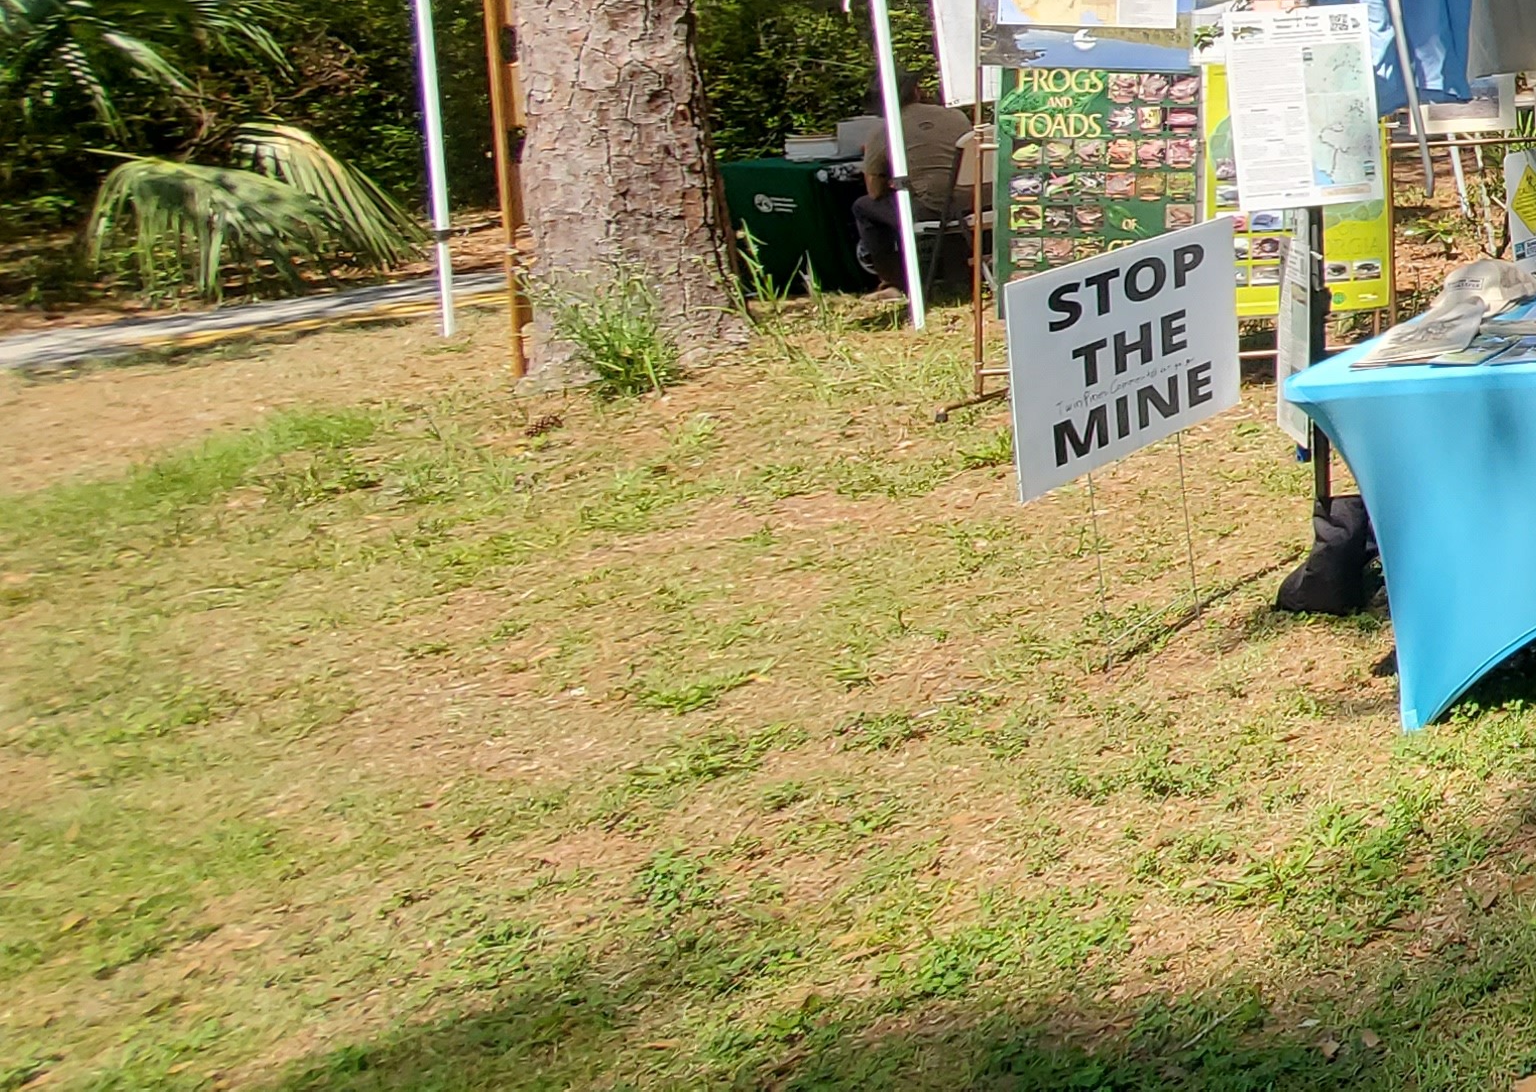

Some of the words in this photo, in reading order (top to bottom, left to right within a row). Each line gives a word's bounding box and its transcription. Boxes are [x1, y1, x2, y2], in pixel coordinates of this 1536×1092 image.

[1016, 68, 1104, 94] FROGS
[1047, 96, 1073, 108] AND
[1013, 113, 1103, 138] TOADS
[1122, 218, 1138, 231] OF
[1047, 242, 1206, 334] STOP
[1070, 308, 1189, 388] THE
[1053, 361, 1213, 468] MINE
